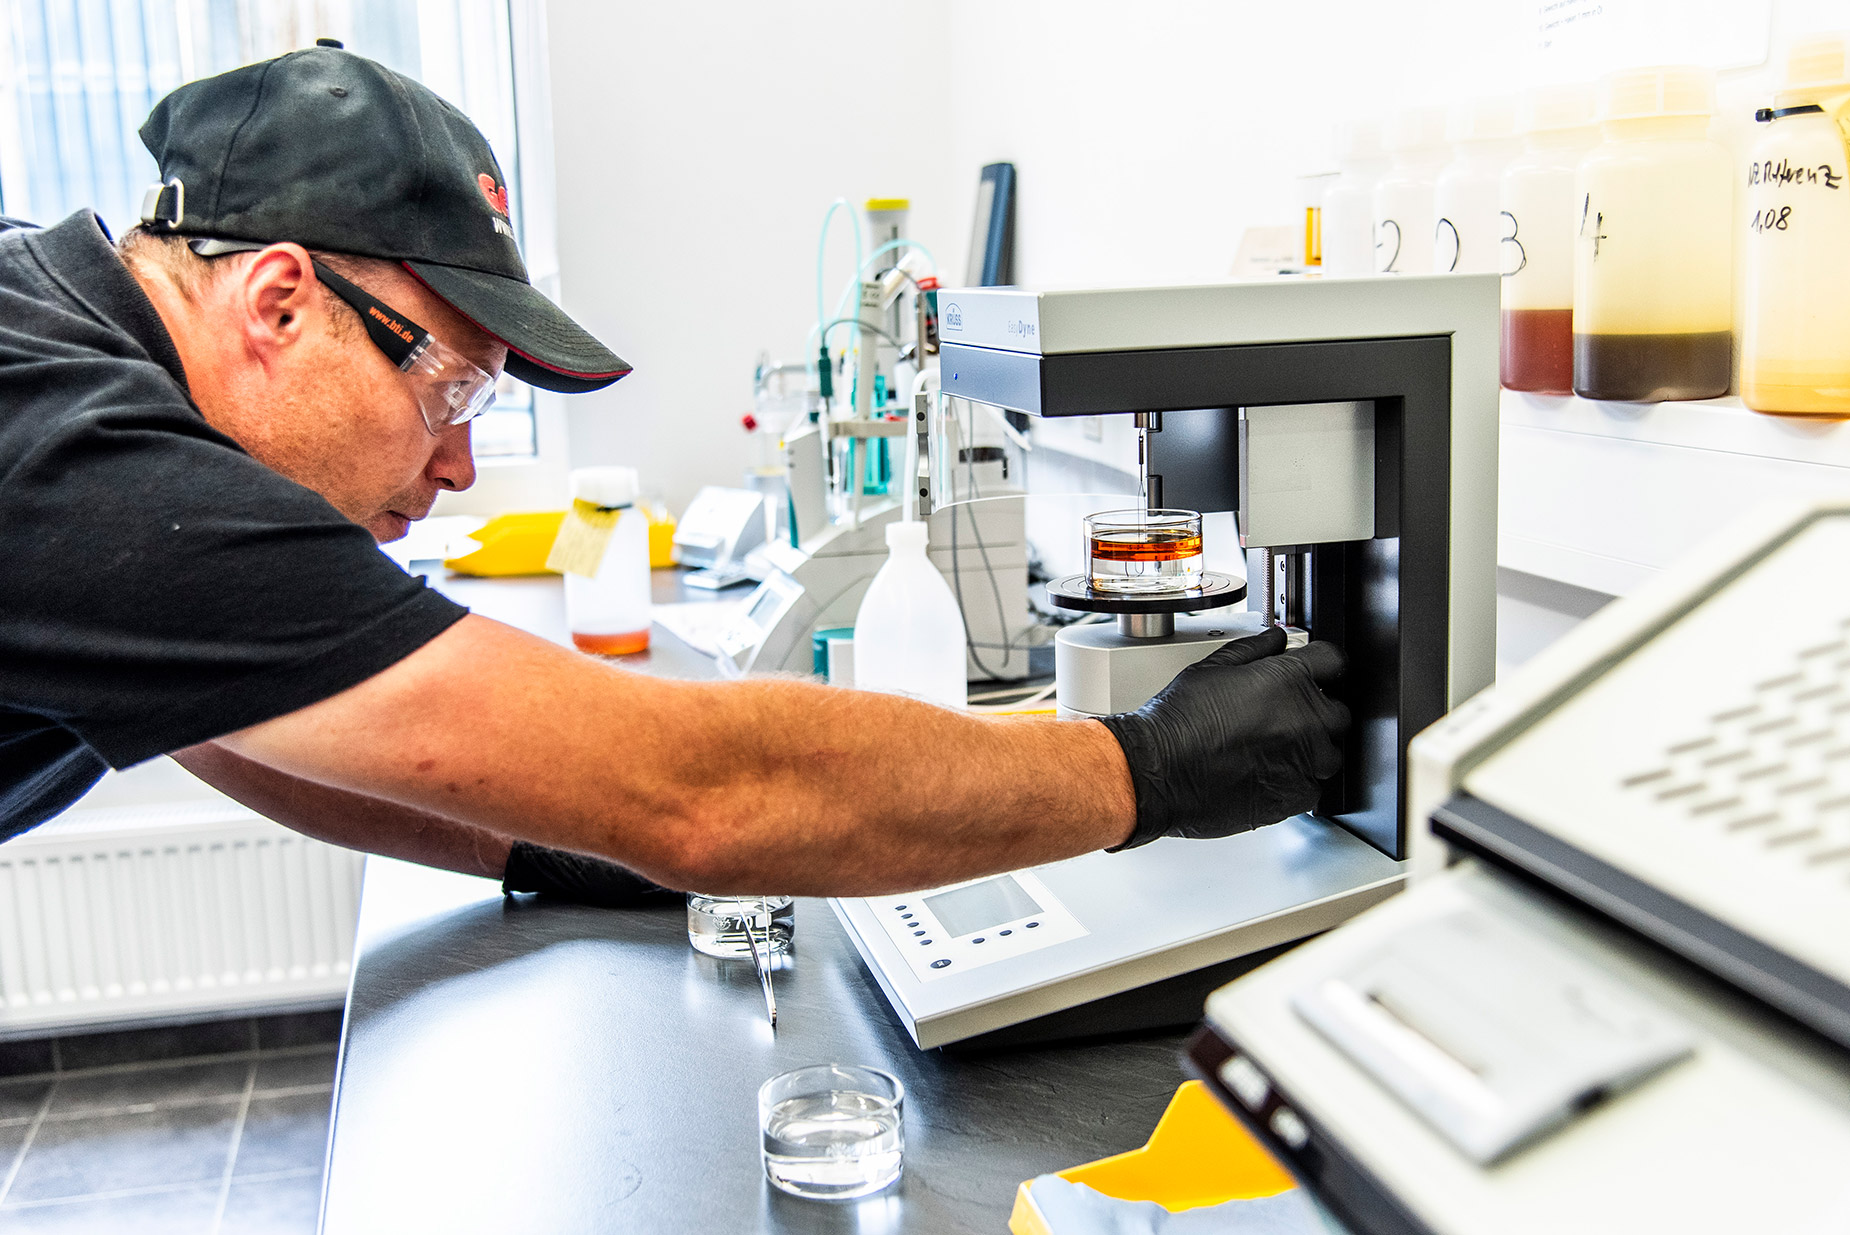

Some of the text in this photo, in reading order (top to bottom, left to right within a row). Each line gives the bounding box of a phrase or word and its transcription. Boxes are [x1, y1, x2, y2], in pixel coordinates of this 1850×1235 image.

[1751, 206, 1792, 234] 1,08
[1500, 211, 1527, 276] 3
[369, 306, 414, 343] www.bti.de
